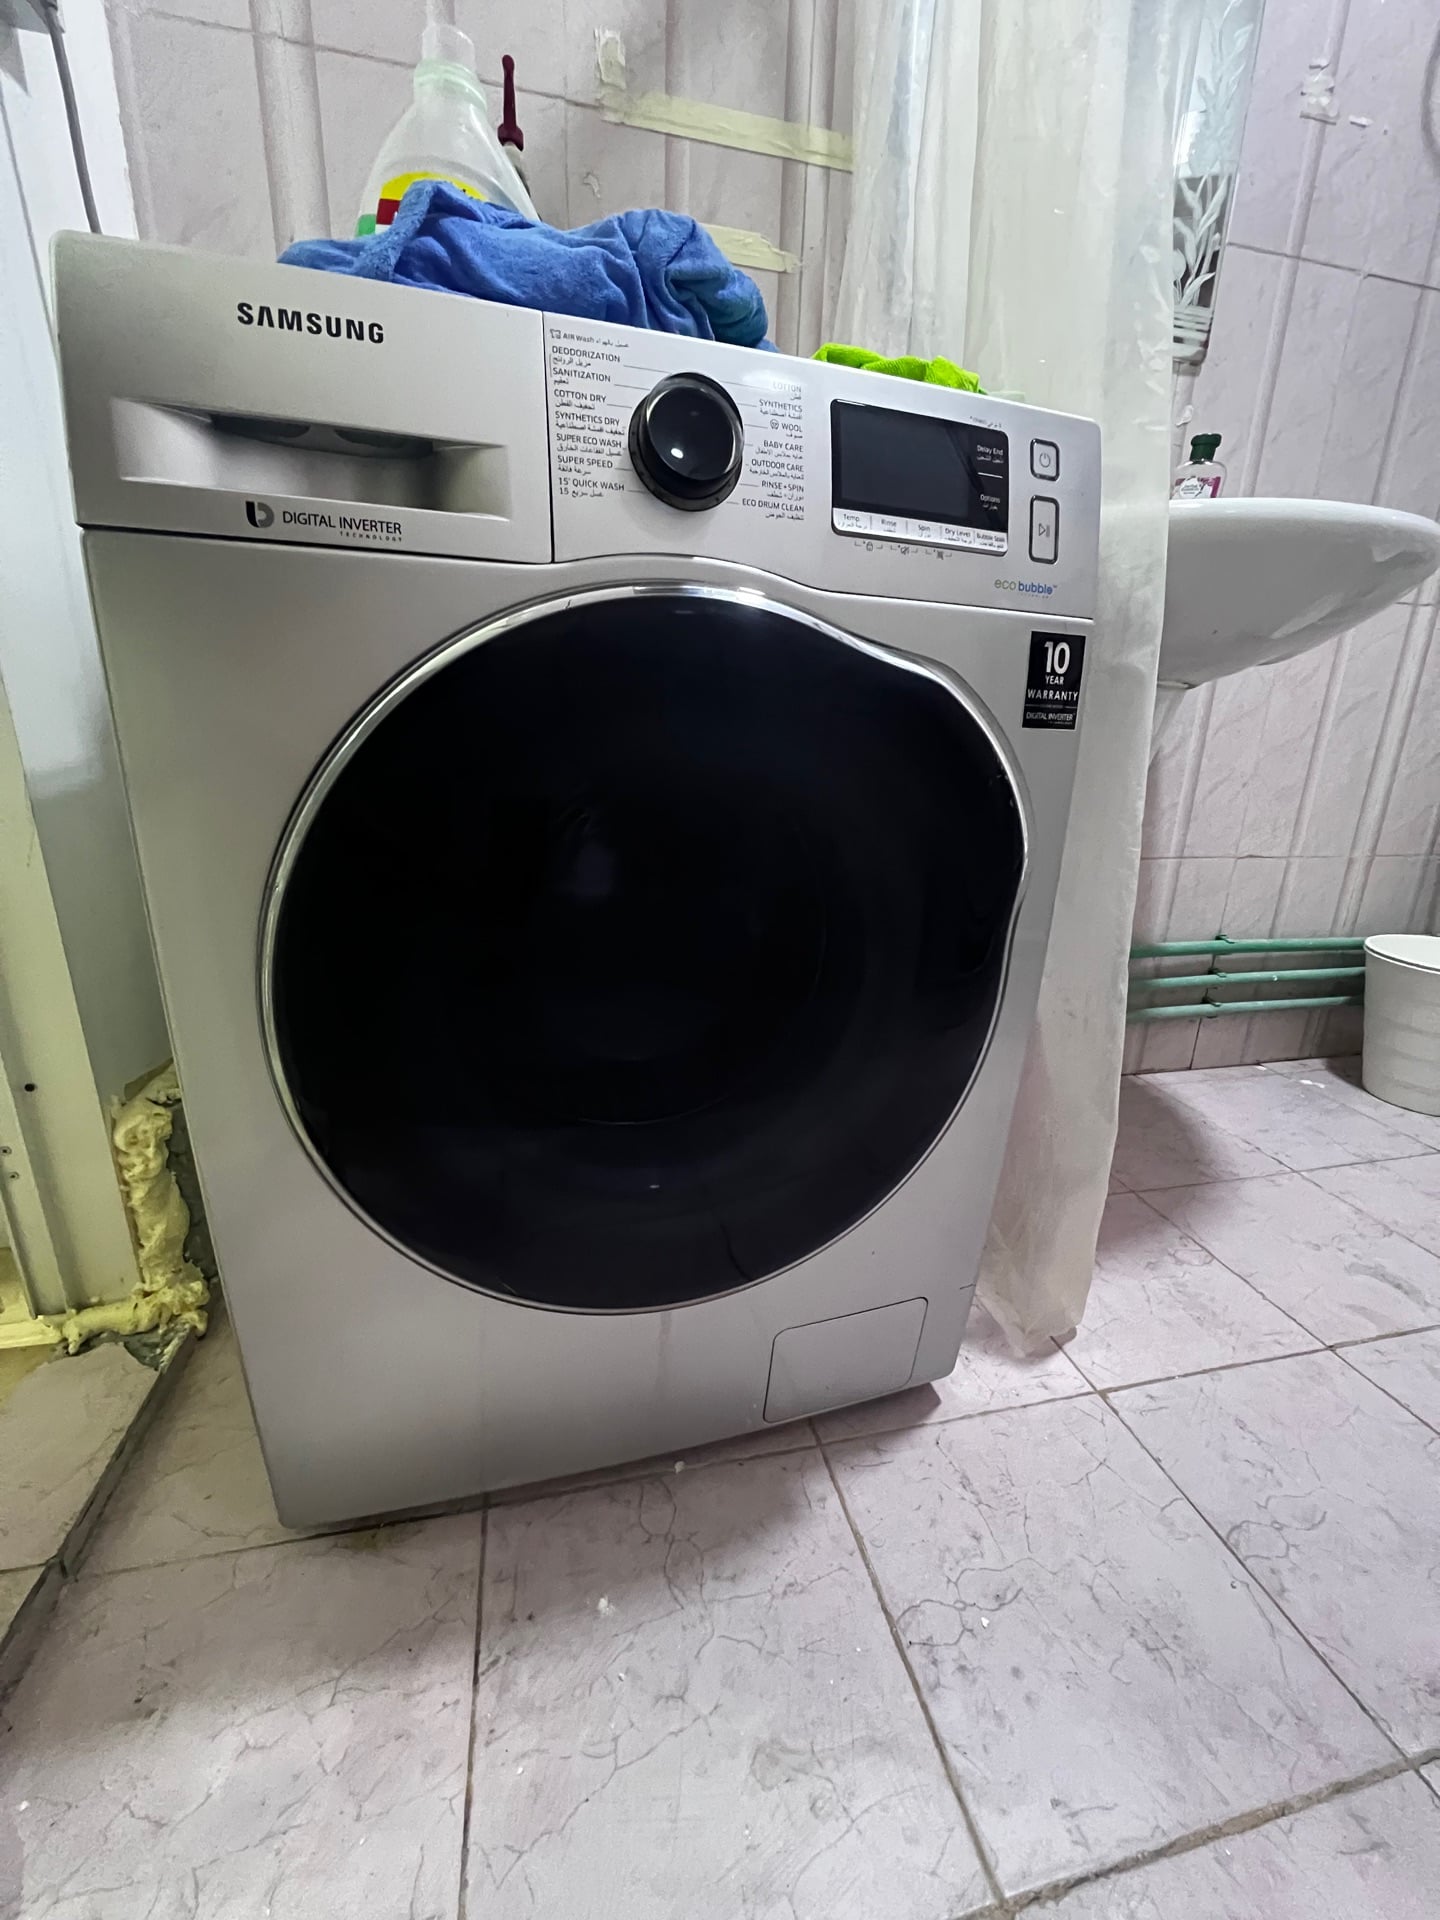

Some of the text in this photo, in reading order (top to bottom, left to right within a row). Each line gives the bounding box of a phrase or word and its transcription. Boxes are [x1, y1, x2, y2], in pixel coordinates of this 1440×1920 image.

[237, 302, 384, 344] SAMSUNG
[576, 335, 594, 343] Wash
[552, 346, 620, 362] DEODORIZATION
[553, 368, 610, 382] SANITIZATION
[554, 389, 606, 402] COTTON DRY
[759, 399, 802, 412] SYNTHETICS
[555, 411, 619, 426] SYNTHETICS DRY
[782, 423, 802, 432] WOOL
[556, 433, 621, 448] SUPER ECO WASH
[764, 440, 804, 452] BABY CARE
[977, 445, 1003, 456] Delay End
[558, 456, 613, 468] SUPER SPEED
[752, 459, 804, 472] OUTDOOR CARE
[572, 479, 598, 488] QUICK
[600, 482, 624, 491] WASH
[762, 480, 782, 490] RINSE
[788, 484, 804, 492] SPIN
[980, 494, 1000, 503] Options
[742, 498, 804, 512] ECO DRUM CLEAN
[283, 511, 402, 534] DIGITAL INVERTER
[340, 531, 402, 542] TECHNOLOGY
[945, 528, 955, 536] Dry
[994, 579, 1016, 590] eco
[1045, 641, 1070, 674] 10
[1045, 675, 1064, 685] YEAR
[1028, 689, 1078, 701] WARRANTY
[1026, 712, 1073, 721] DIGITAL INVERTER
